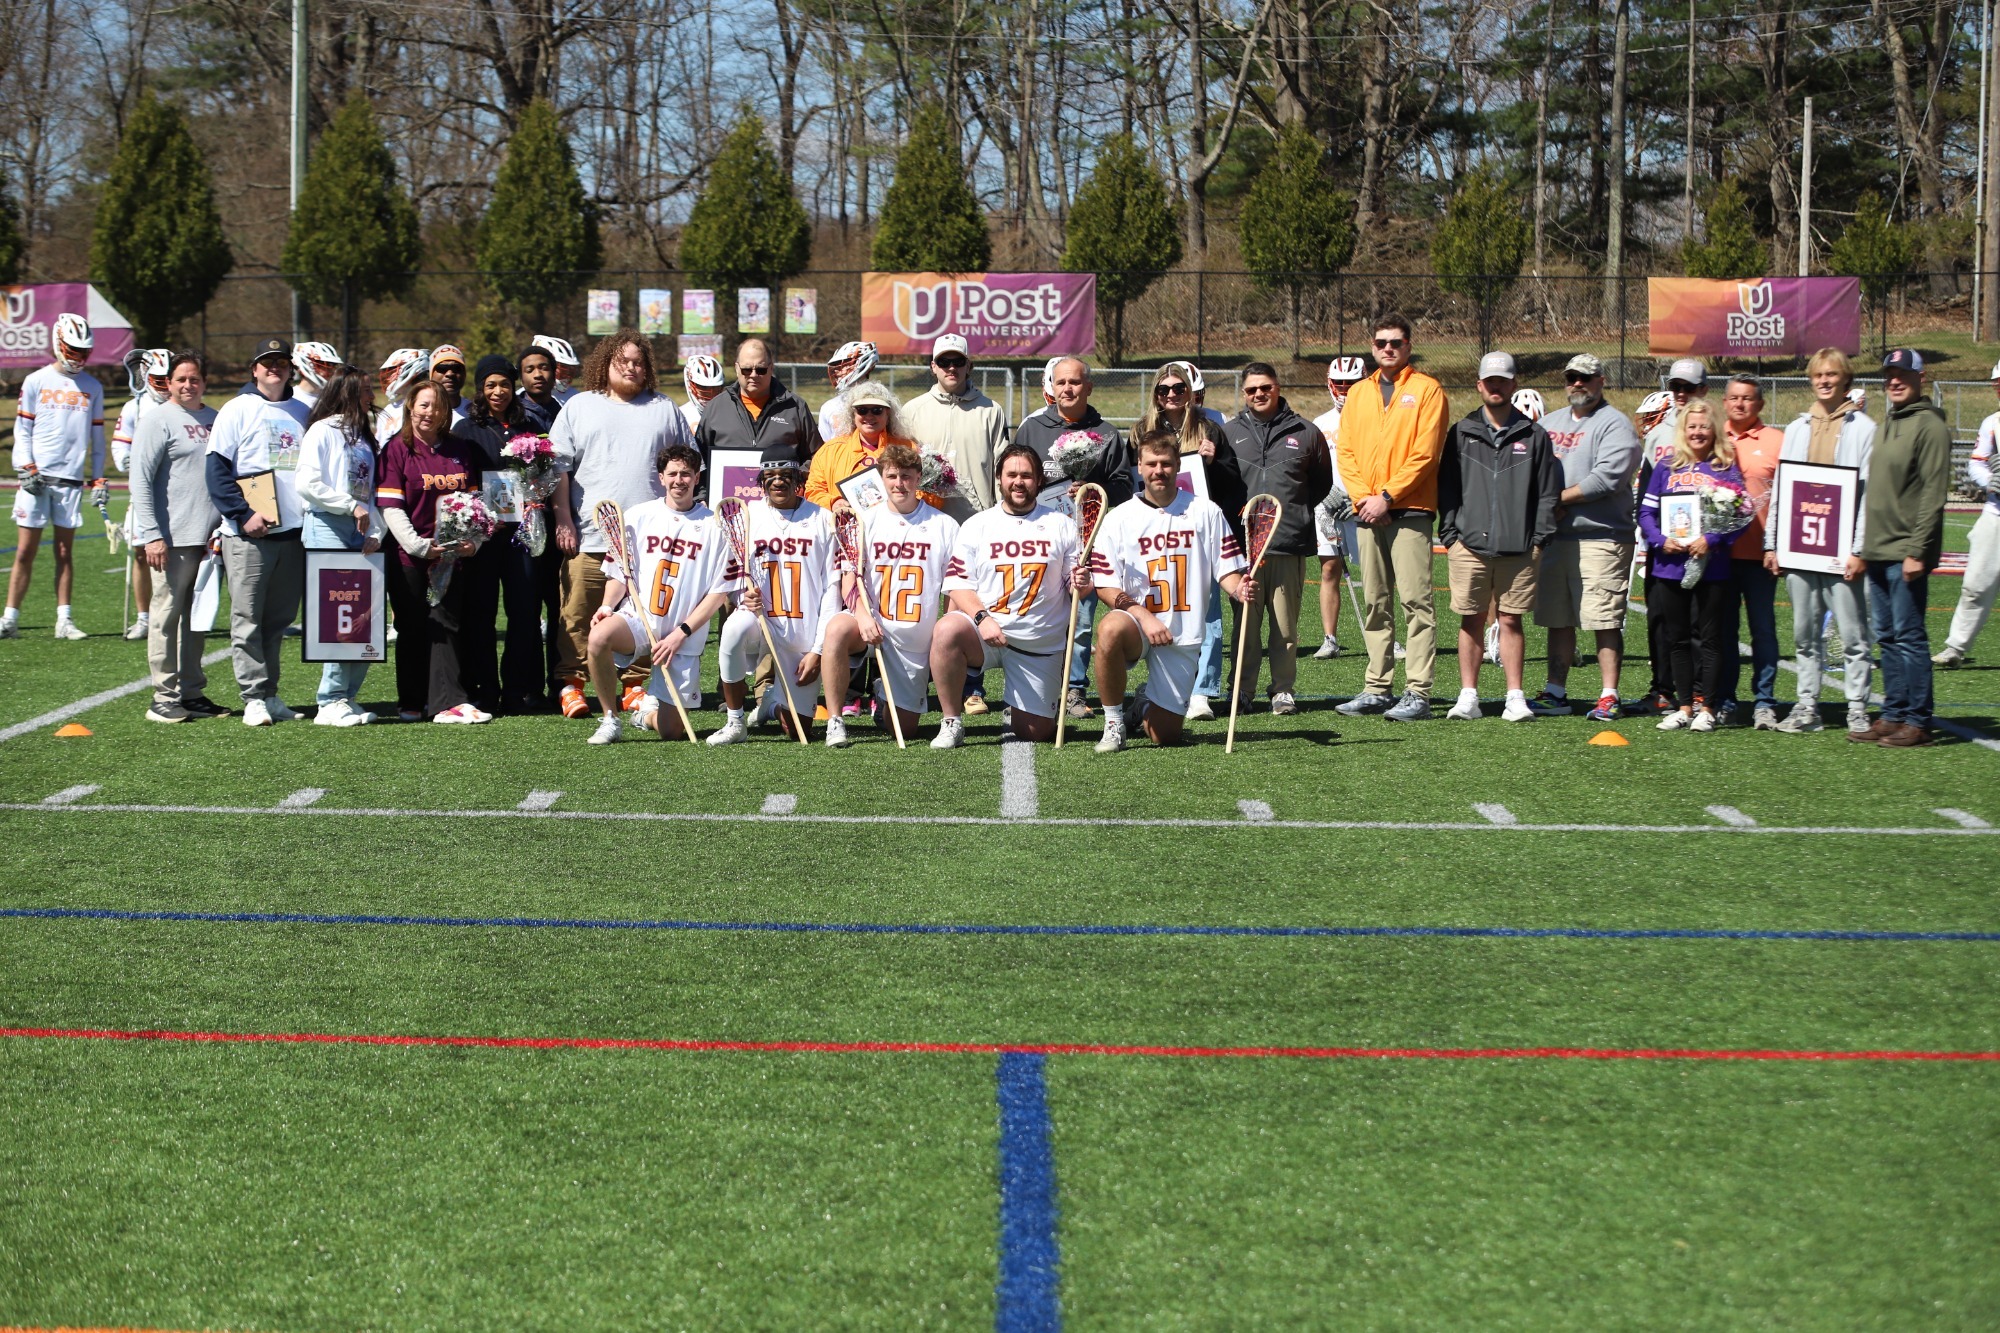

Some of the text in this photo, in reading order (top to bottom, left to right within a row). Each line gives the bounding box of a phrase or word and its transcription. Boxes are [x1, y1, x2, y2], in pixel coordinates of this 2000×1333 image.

[956, 281, 1061, 326] Post
[0, 322, 49, 350] ost
[959, 325, 1056, 337] UNIVERSITY
[1727, 313, 1785, 340] Post
[40, 389, 91, 407] POST
[183, 424, 213, 439] POS
[422, 473, 467, 490] POST
[1800, 502, 1832, 515] POST
[1138, 530, 1194, 555] POST
[1802, 515, 1827, 546] 51
[646, 536, 702, 560] POST
[754, 537, 812, 557] POST
[874, 542, 931, 560] POST
[990, 540, 1051, 559] POST
[329, 590, 360, 601] POST
[650, 559, 680, 617] 6
[762, 561, 803, 619] 11
[875, 565, 924, 622] 12
[990, 563, 1047, 616] 17
[1145, 554, 1190, 613] 51
[338, 604, 352, 633] 6
